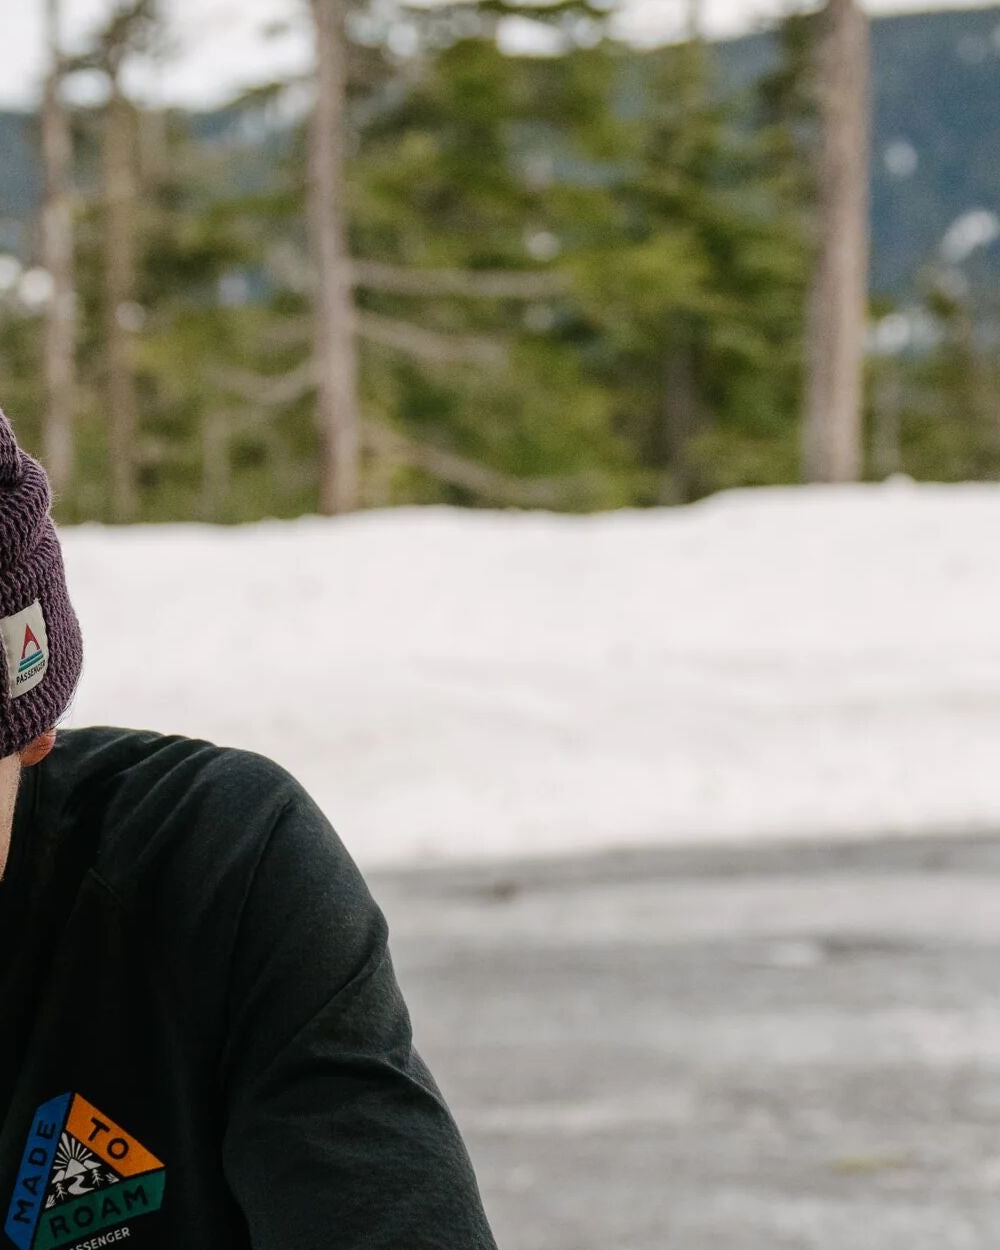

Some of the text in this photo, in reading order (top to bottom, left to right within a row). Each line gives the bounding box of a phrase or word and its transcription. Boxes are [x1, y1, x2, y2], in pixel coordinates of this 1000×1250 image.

[88, 1117, 129, 1160] TO
[13, 1120, 56, 1224] MADE
[49, 1185, 149, 1239] ROAM
